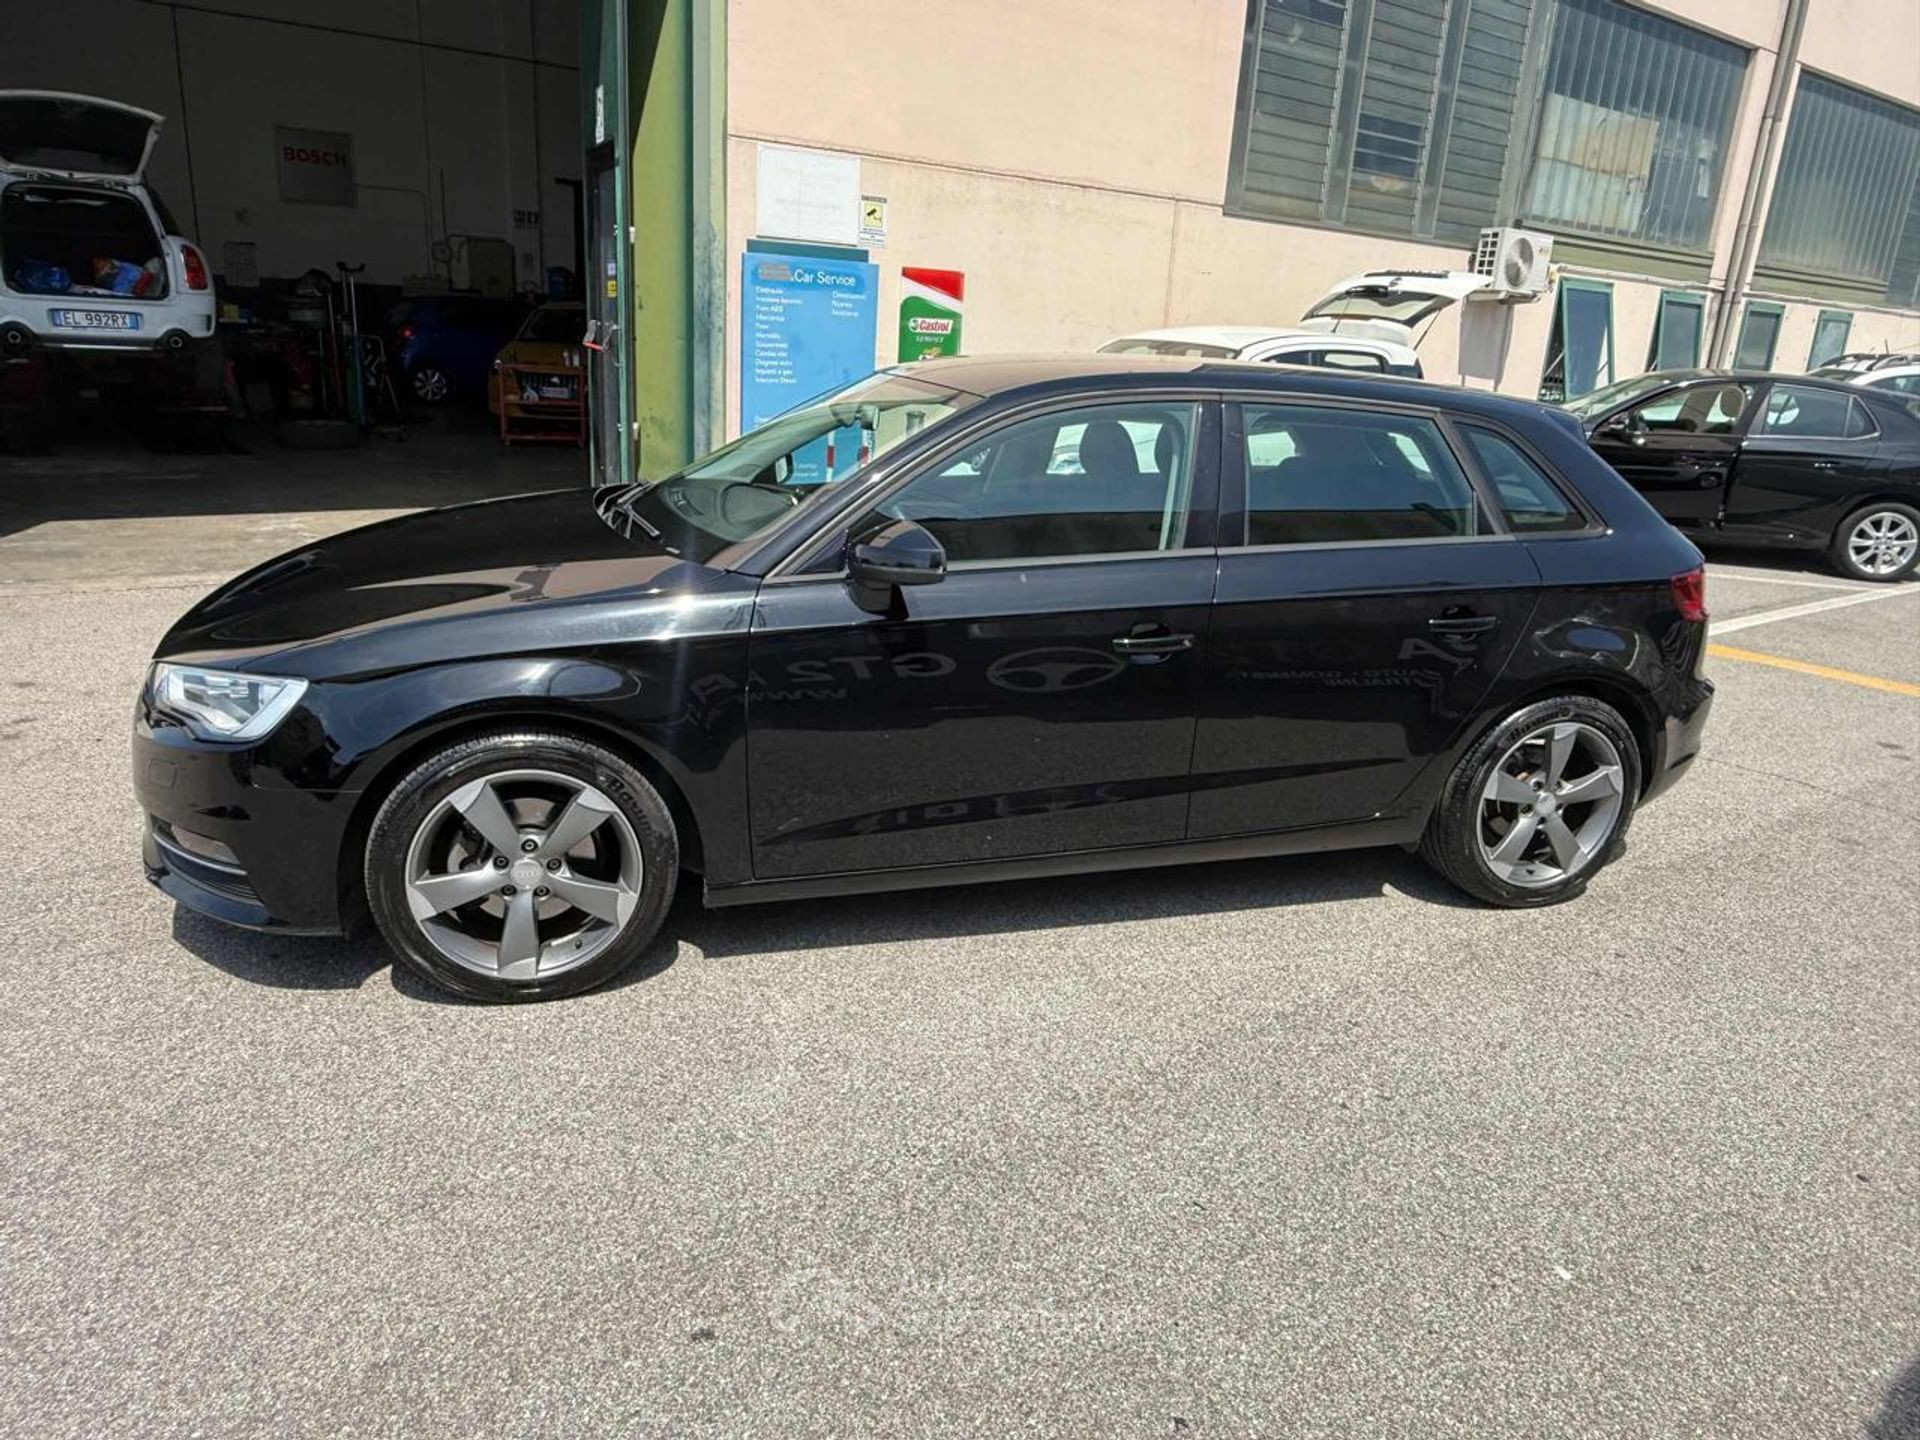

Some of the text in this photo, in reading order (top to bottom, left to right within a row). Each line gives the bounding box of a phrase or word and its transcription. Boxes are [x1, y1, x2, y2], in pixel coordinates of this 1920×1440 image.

[283, 146, 347, 168] BOSCH
[794, 269, 856, 287] Car Service
[63, 311, 129, 329] EL 992RX
[919, 320, 949, 332] Castrol
